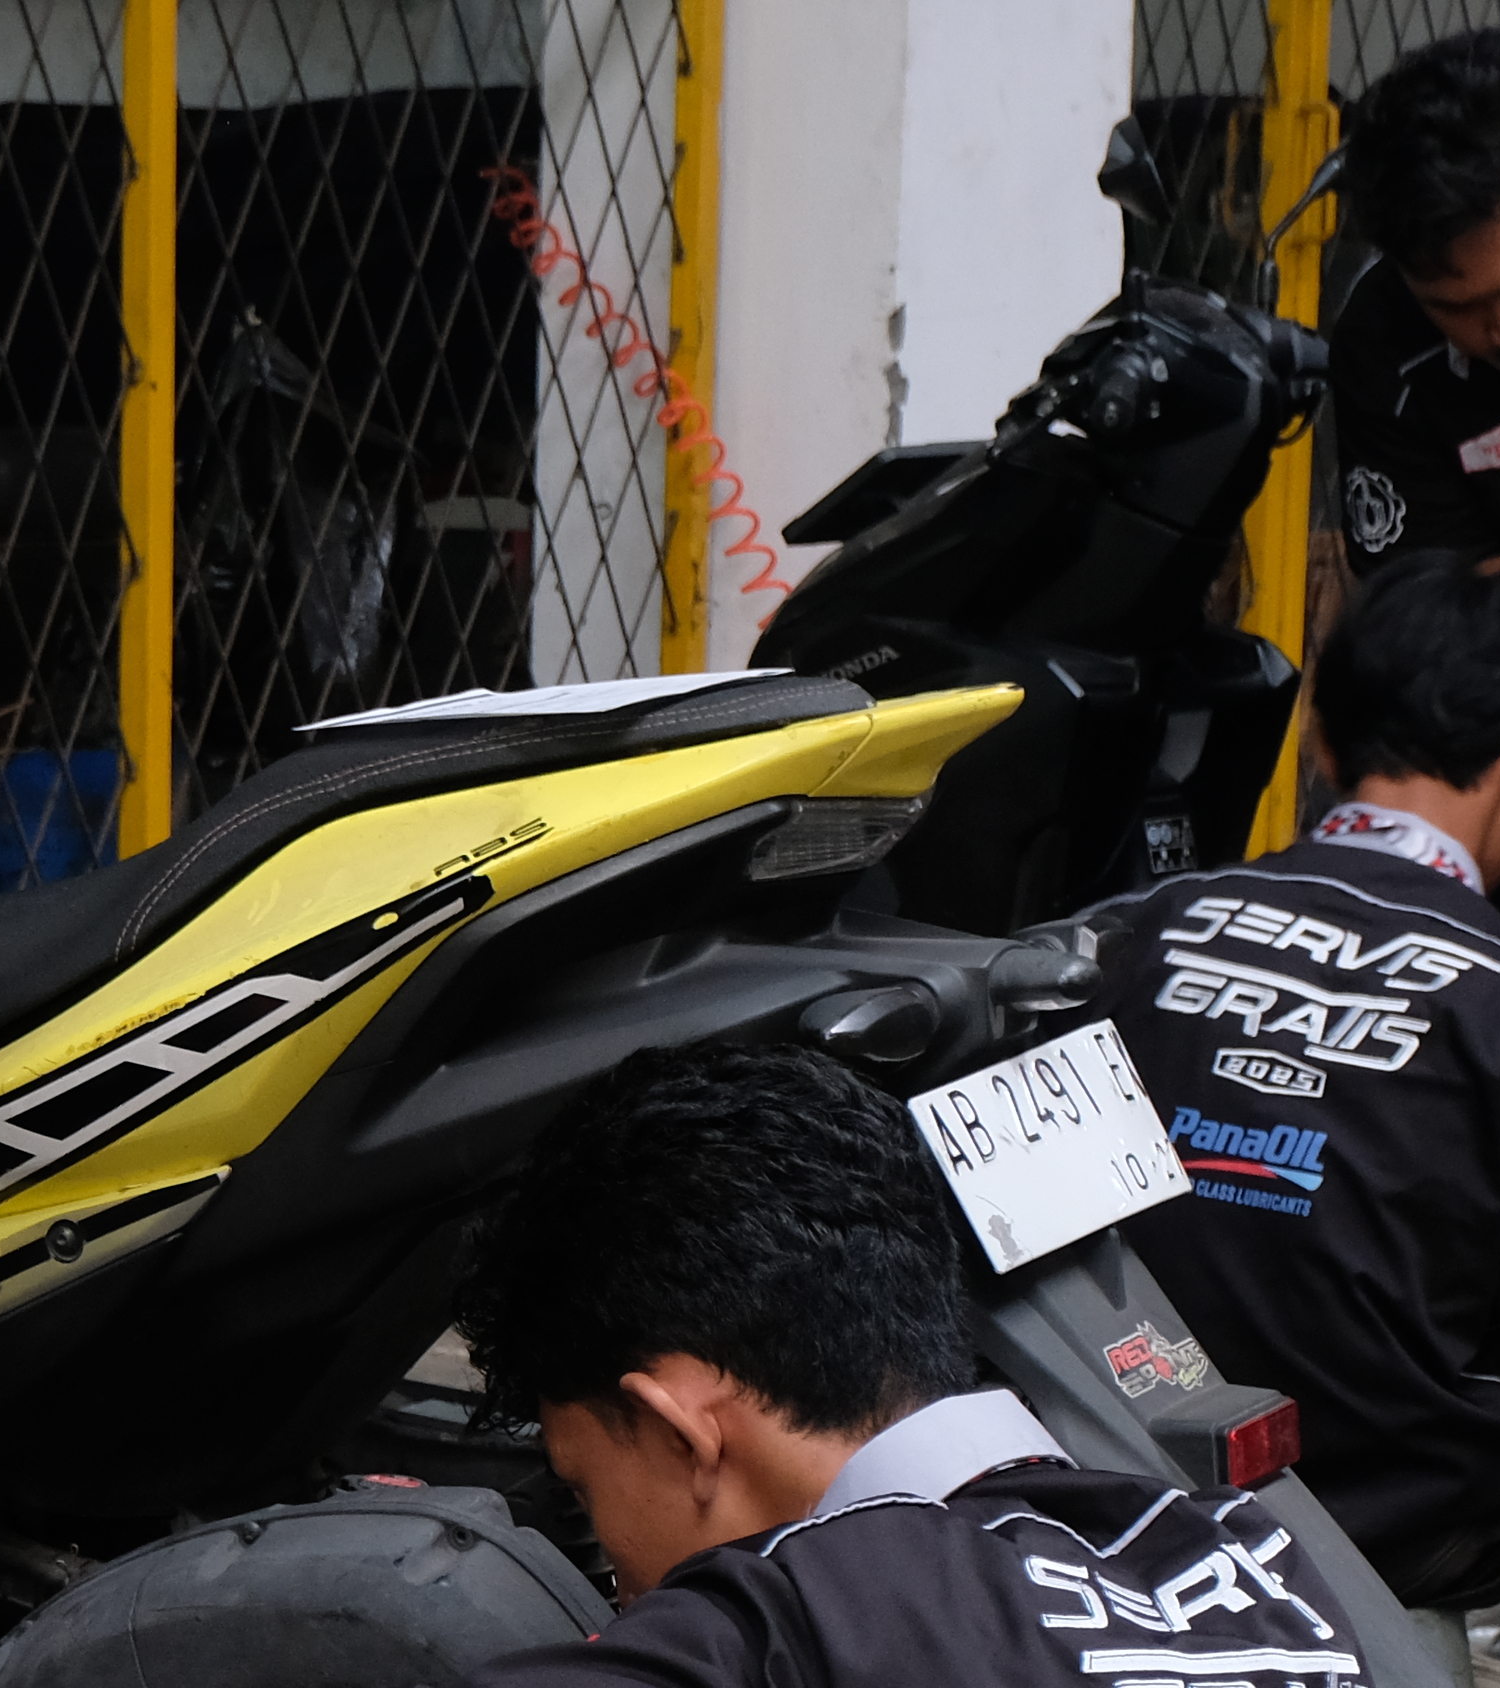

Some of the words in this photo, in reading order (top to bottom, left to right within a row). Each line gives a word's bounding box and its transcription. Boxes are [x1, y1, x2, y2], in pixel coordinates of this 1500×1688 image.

[822, 644, 901, 680] ONDA
[434, 817, 547, 877] ABS
[1154, 948, 1433, 1073] GRATIS
[1224, 1053, 1321, 1093] 2025
[929, 1089, 996, 1176] AB
[991, 1048, 1102, 1142] 2491
[1168, 1105, 1328, 1173] PanaOIL
[1195, 1178, 1237, 1204] CLASS
[1234, 1186, 1313, 1218] LUBRICANTS
